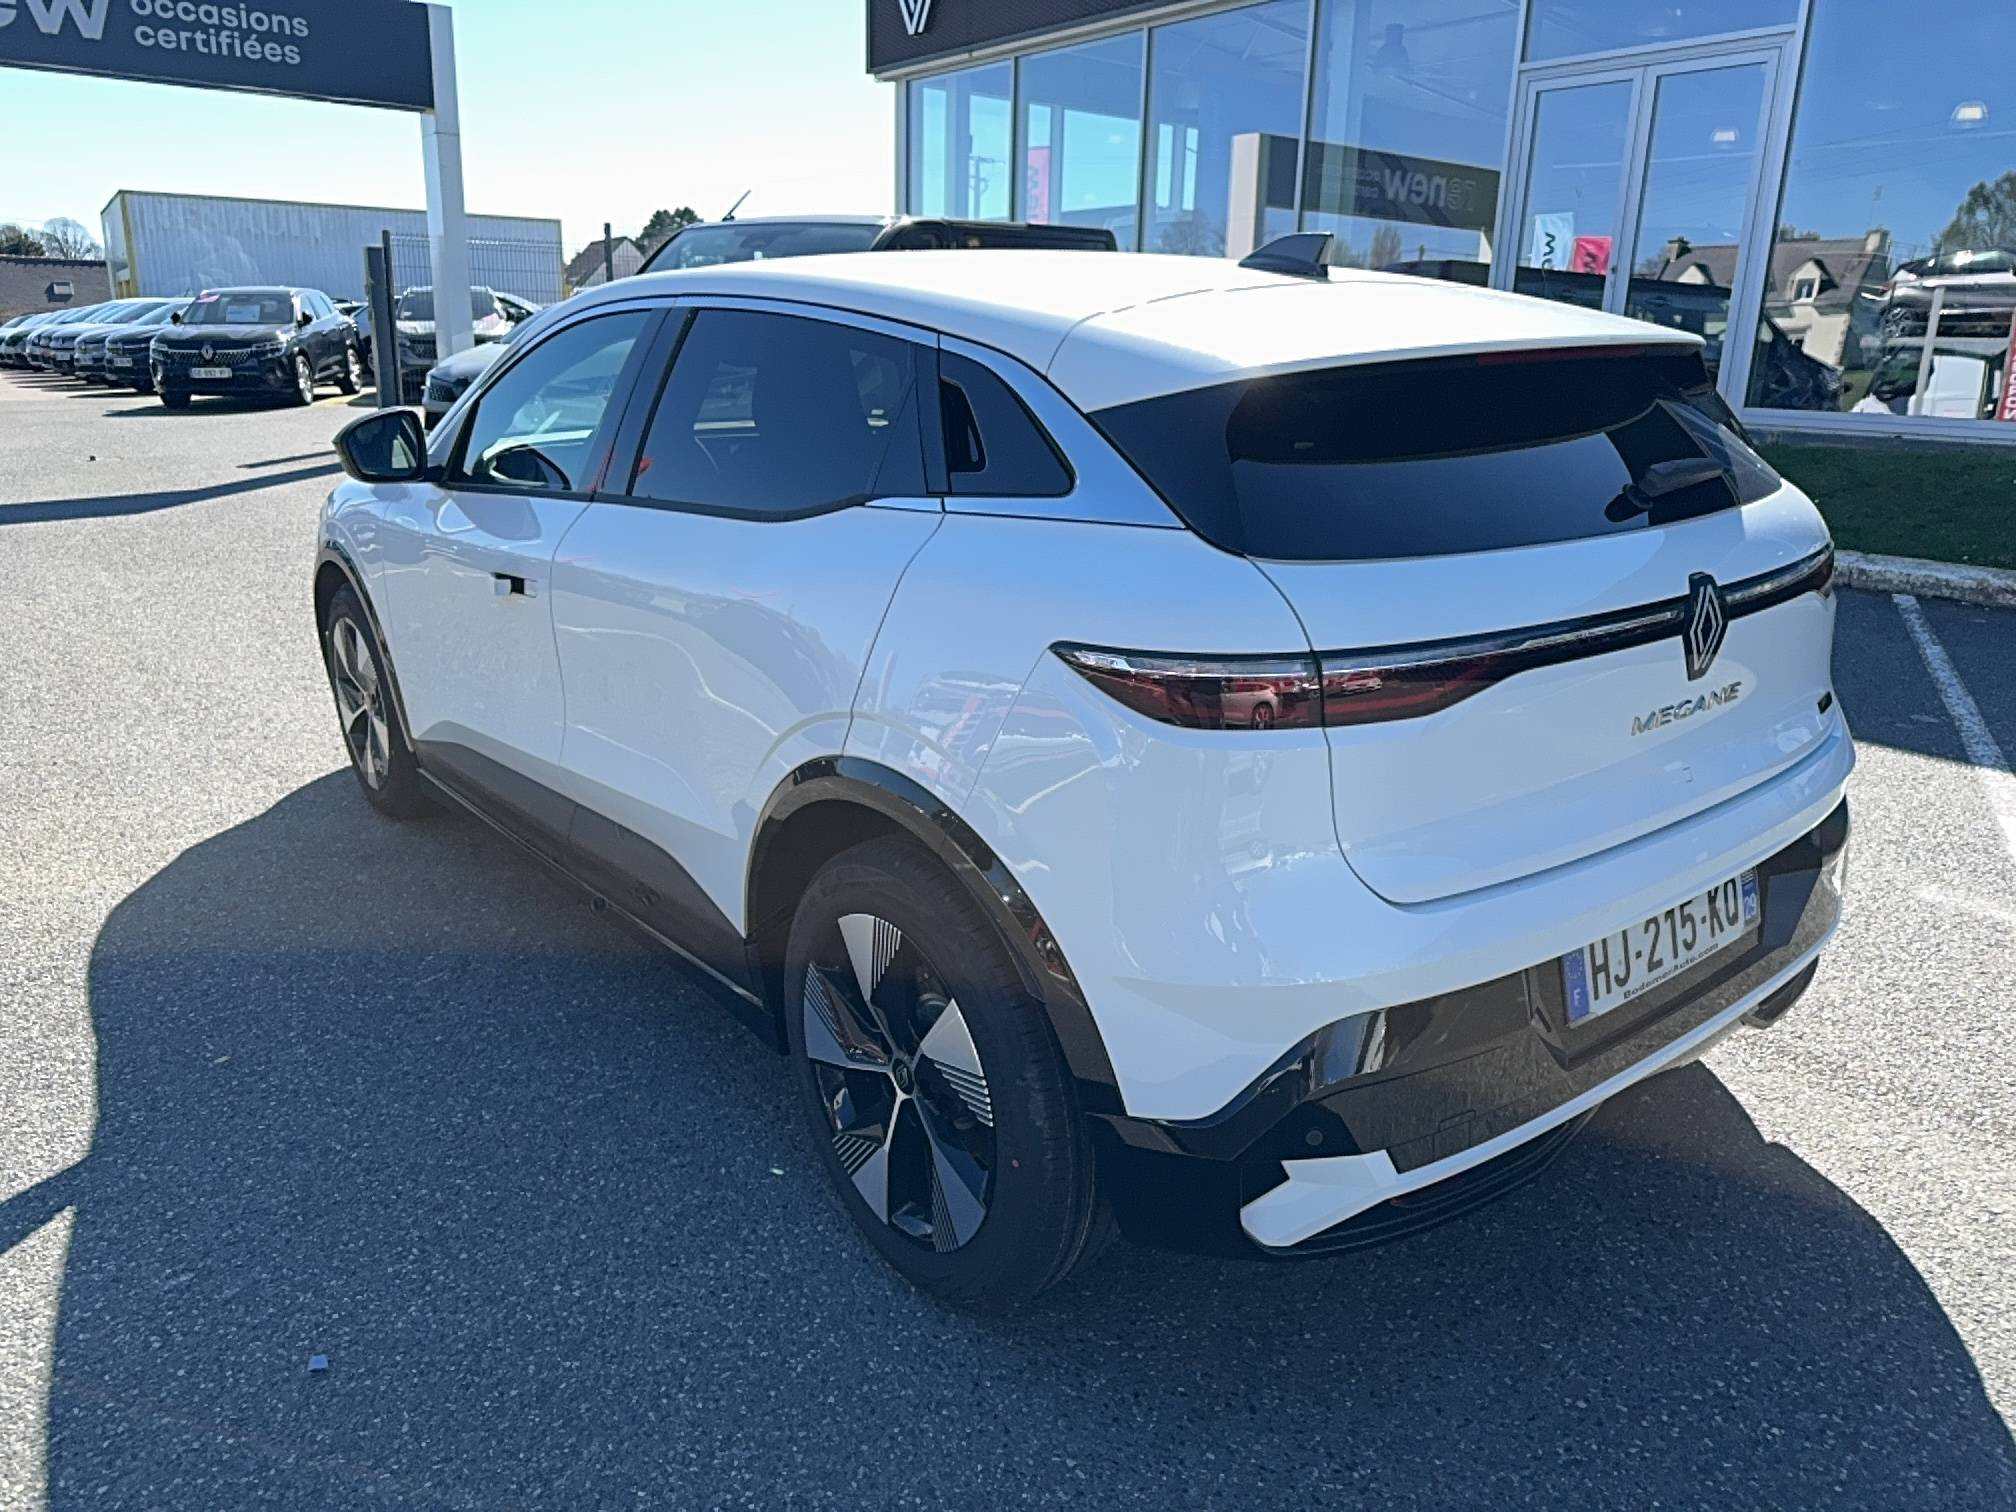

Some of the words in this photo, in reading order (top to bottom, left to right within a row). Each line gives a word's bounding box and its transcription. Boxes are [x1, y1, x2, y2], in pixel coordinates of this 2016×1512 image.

[131, 0, 309, 37] occasions
[134, 25, 301, 64] certifiées
[1630, 681, 1742, 736] MEGANE
[1589, 877, 1739, 1000] HJ-215-KQ
[1573, 989, 1581, 1007] F
